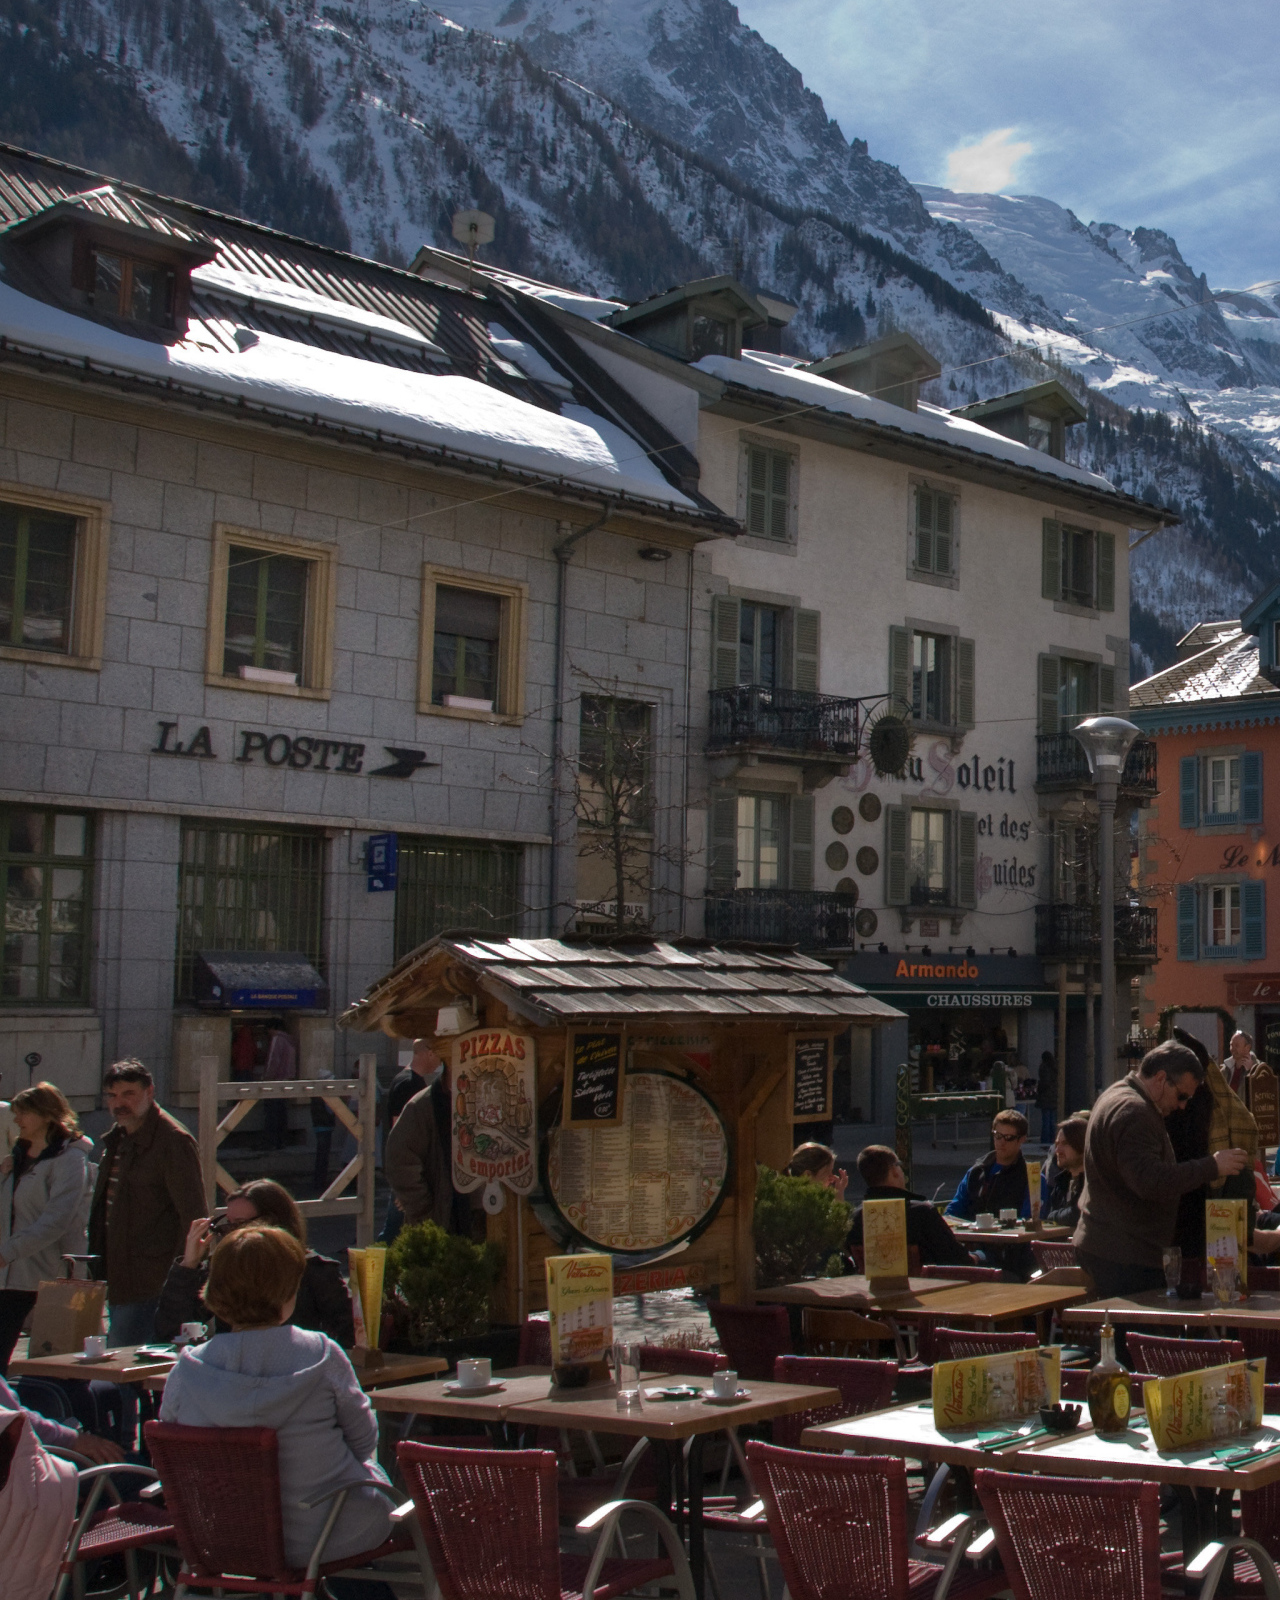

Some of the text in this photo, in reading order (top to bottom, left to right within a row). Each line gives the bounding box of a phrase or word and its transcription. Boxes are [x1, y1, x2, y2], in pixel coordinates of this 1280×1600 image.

[152, 721, 365, 774] LA POSTE
[978, 813, 1031, 841] et des
[1219, 845, 1248, 869] Le
[895, 959, 979, 978] Armando
[927, 994, 1033, 1007] CHAUSSURES
[1252, 982, 1271, 997] le
[460, 1033, 526, 1063] PIZZAS
[470, 1149, 531, 1184] emporter
